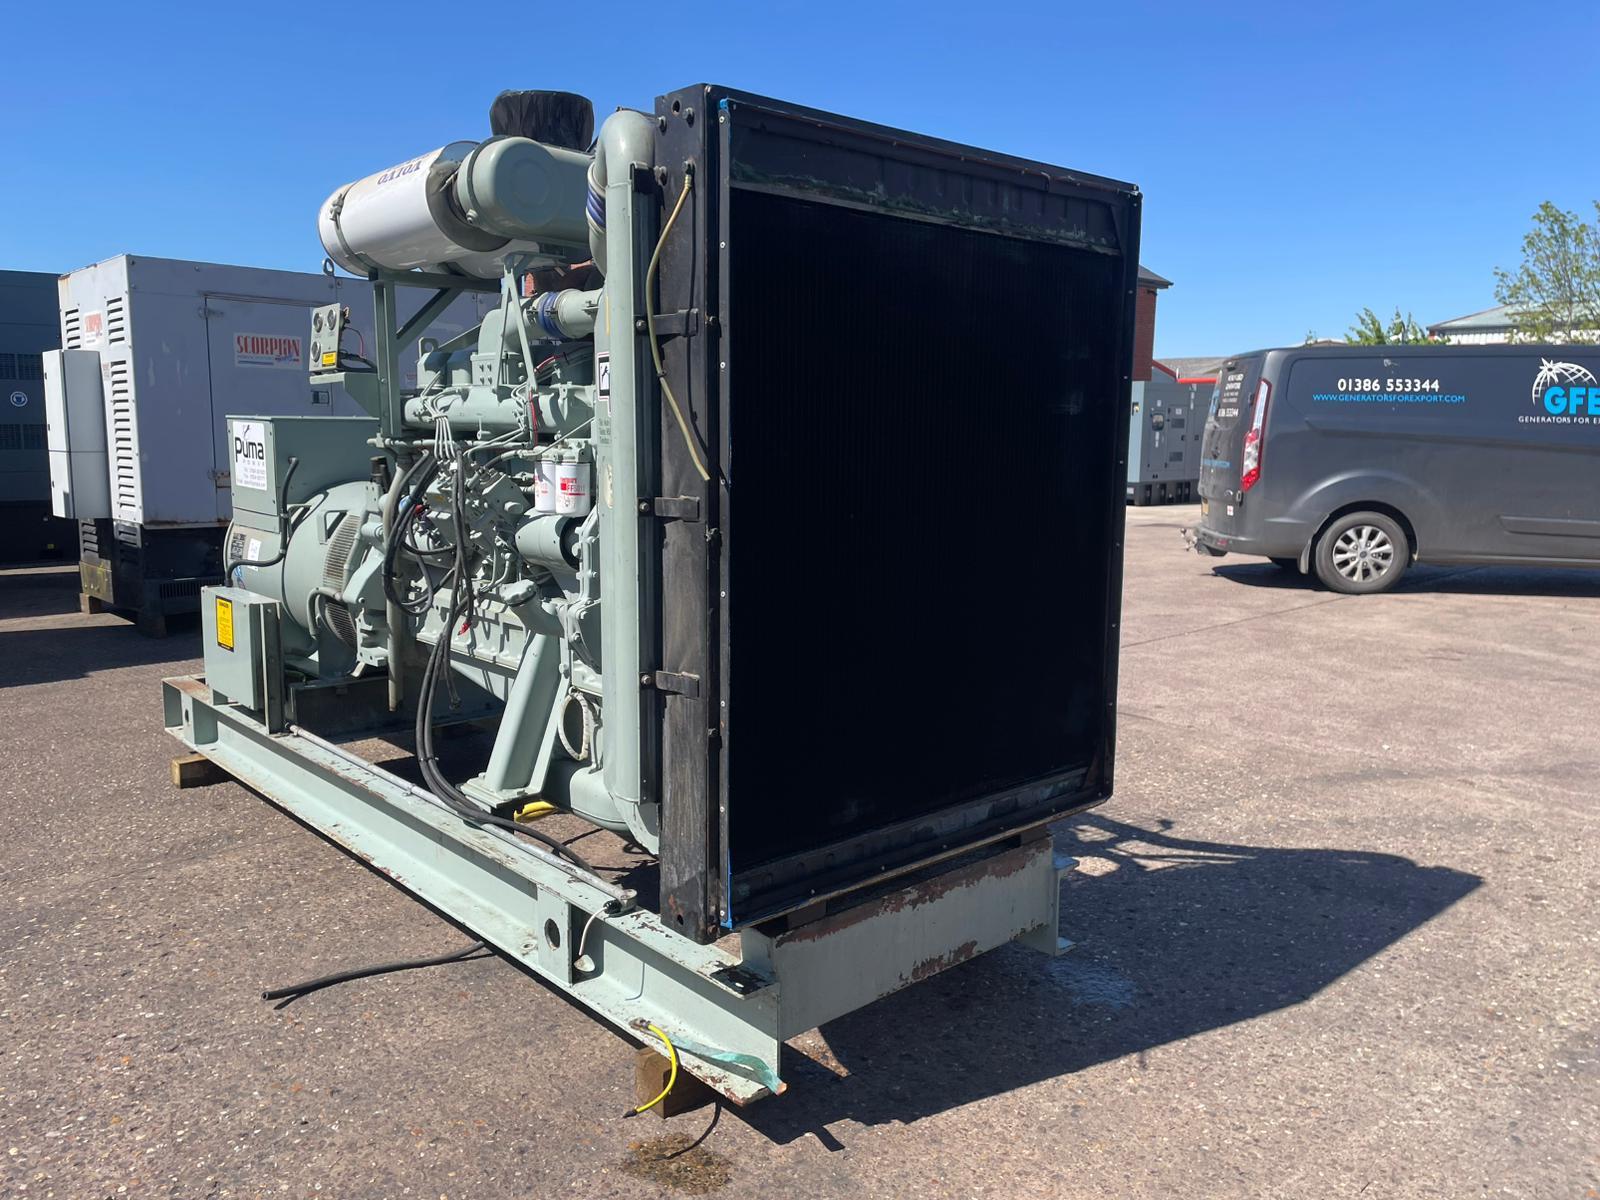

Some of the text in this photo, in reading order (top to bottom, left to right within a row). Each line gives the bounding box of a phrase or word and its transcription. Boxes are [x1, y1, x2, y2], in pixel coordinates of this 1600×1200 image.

[236, 335, 300, 357] SCORPION
[1337, 378, 1440, 393] 01386 553344
[1312, 393, 1465, 403] WWW.GENERATORSFOREXPORT.COM
[1544, 385, 1600, 416] GFE
[1518, 415, 1571, 424] GENERATORS
[1573, 416, 1590, 424] FOR
